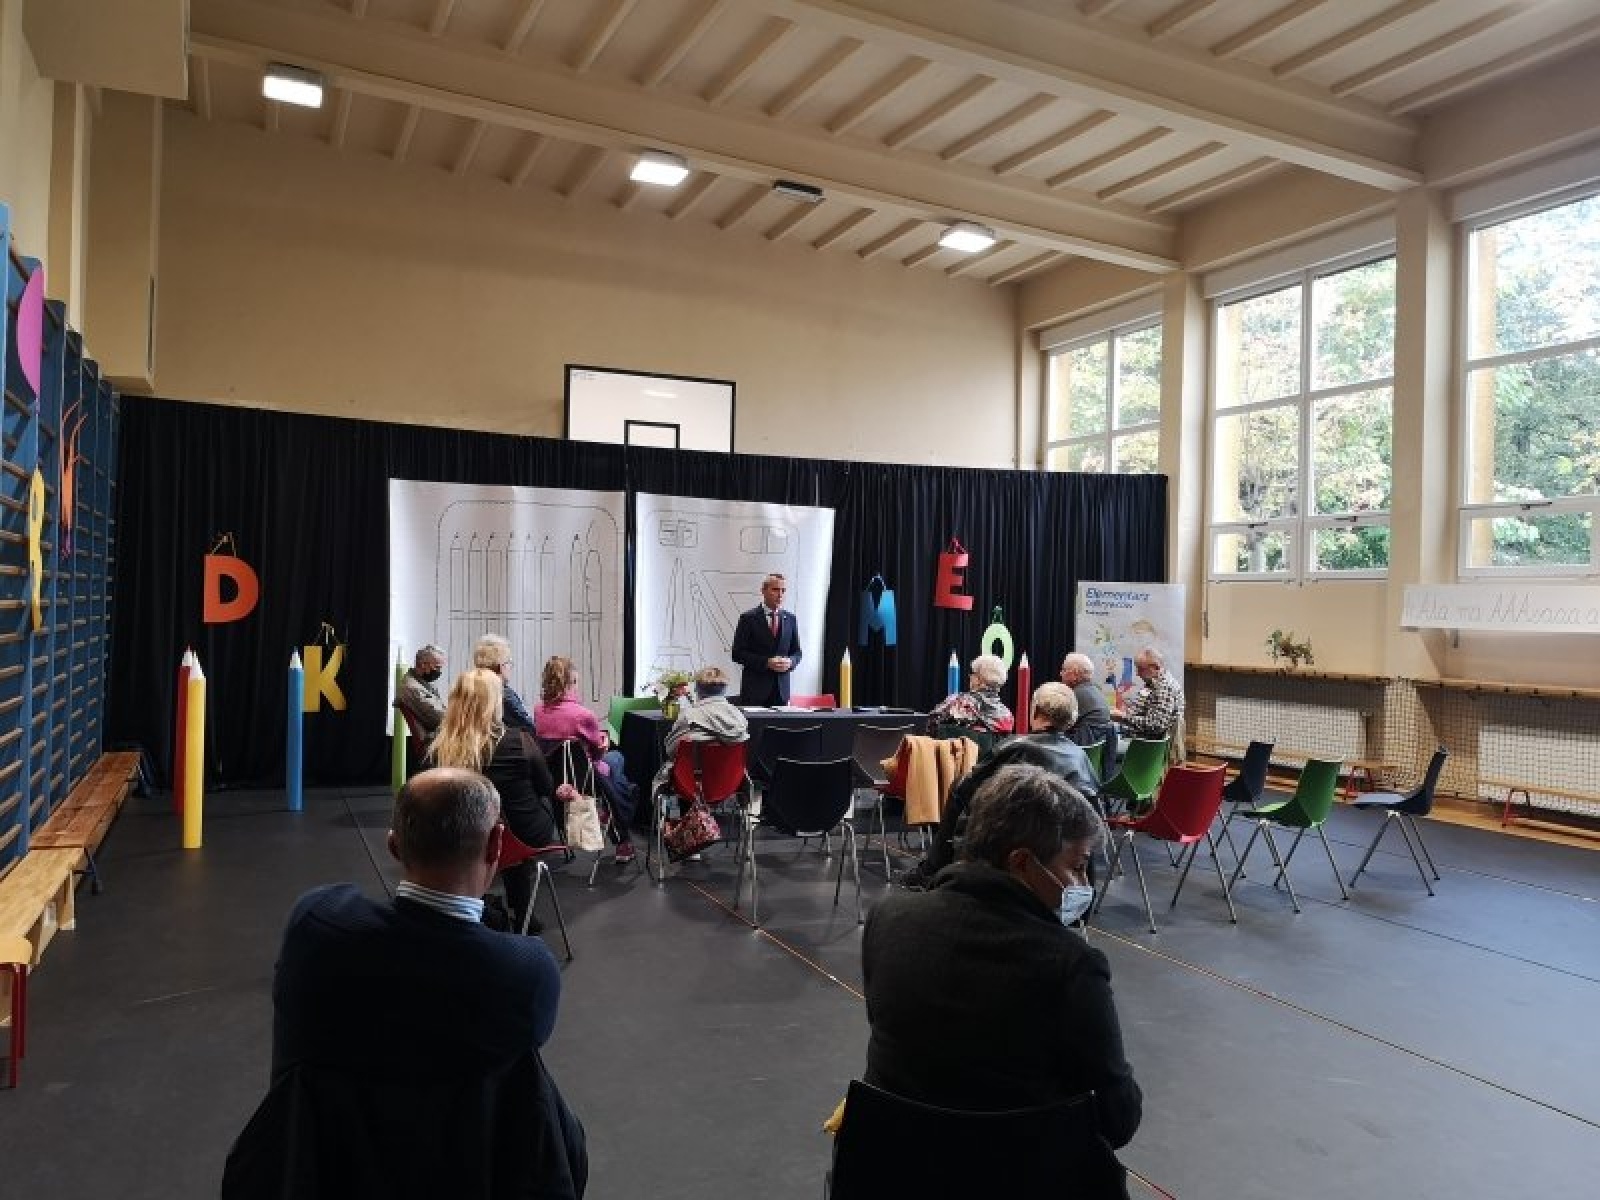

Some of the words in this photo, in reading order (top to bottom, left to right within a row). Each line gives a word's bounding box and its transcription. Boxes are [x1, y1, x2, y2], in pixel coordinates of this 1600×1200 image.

[204, 554, 259, 623] D
[934, 553, 974, 611] E
[859, 590, 897, 646] M
[303, 645, 347, 713] K
